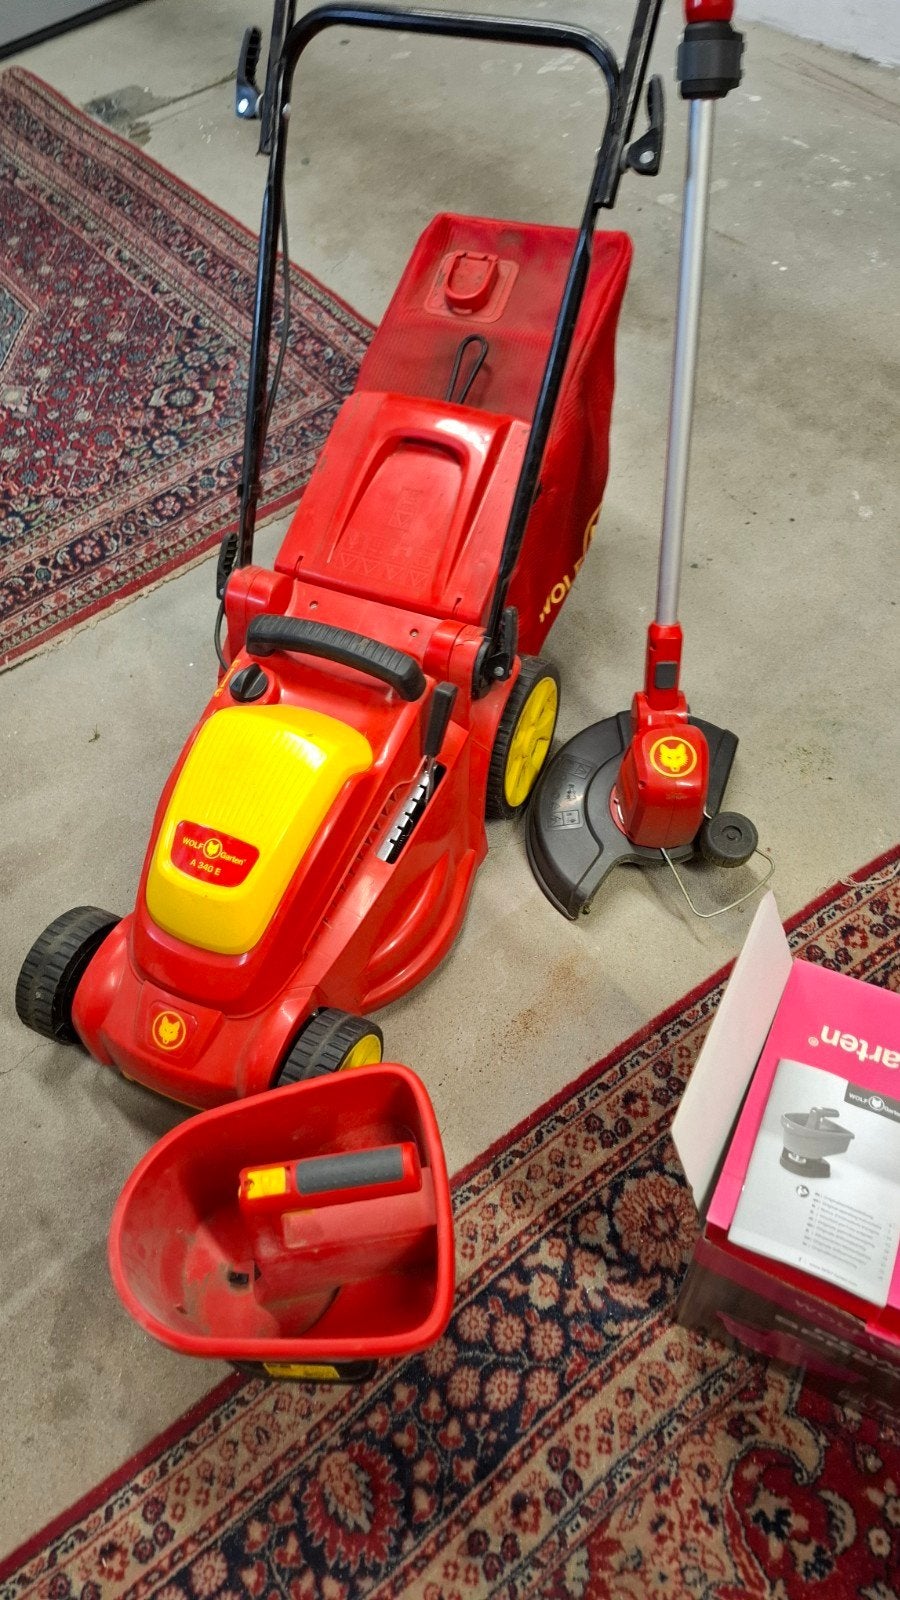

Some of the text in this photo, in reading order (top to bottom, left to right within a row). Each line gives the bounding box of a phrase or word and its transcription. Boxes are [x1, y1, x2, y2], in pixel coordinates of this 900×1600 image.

[182, 836, 205, 850] WOLF
[190, 858, 196, 867] A
[214, 867, 222, 876] E
